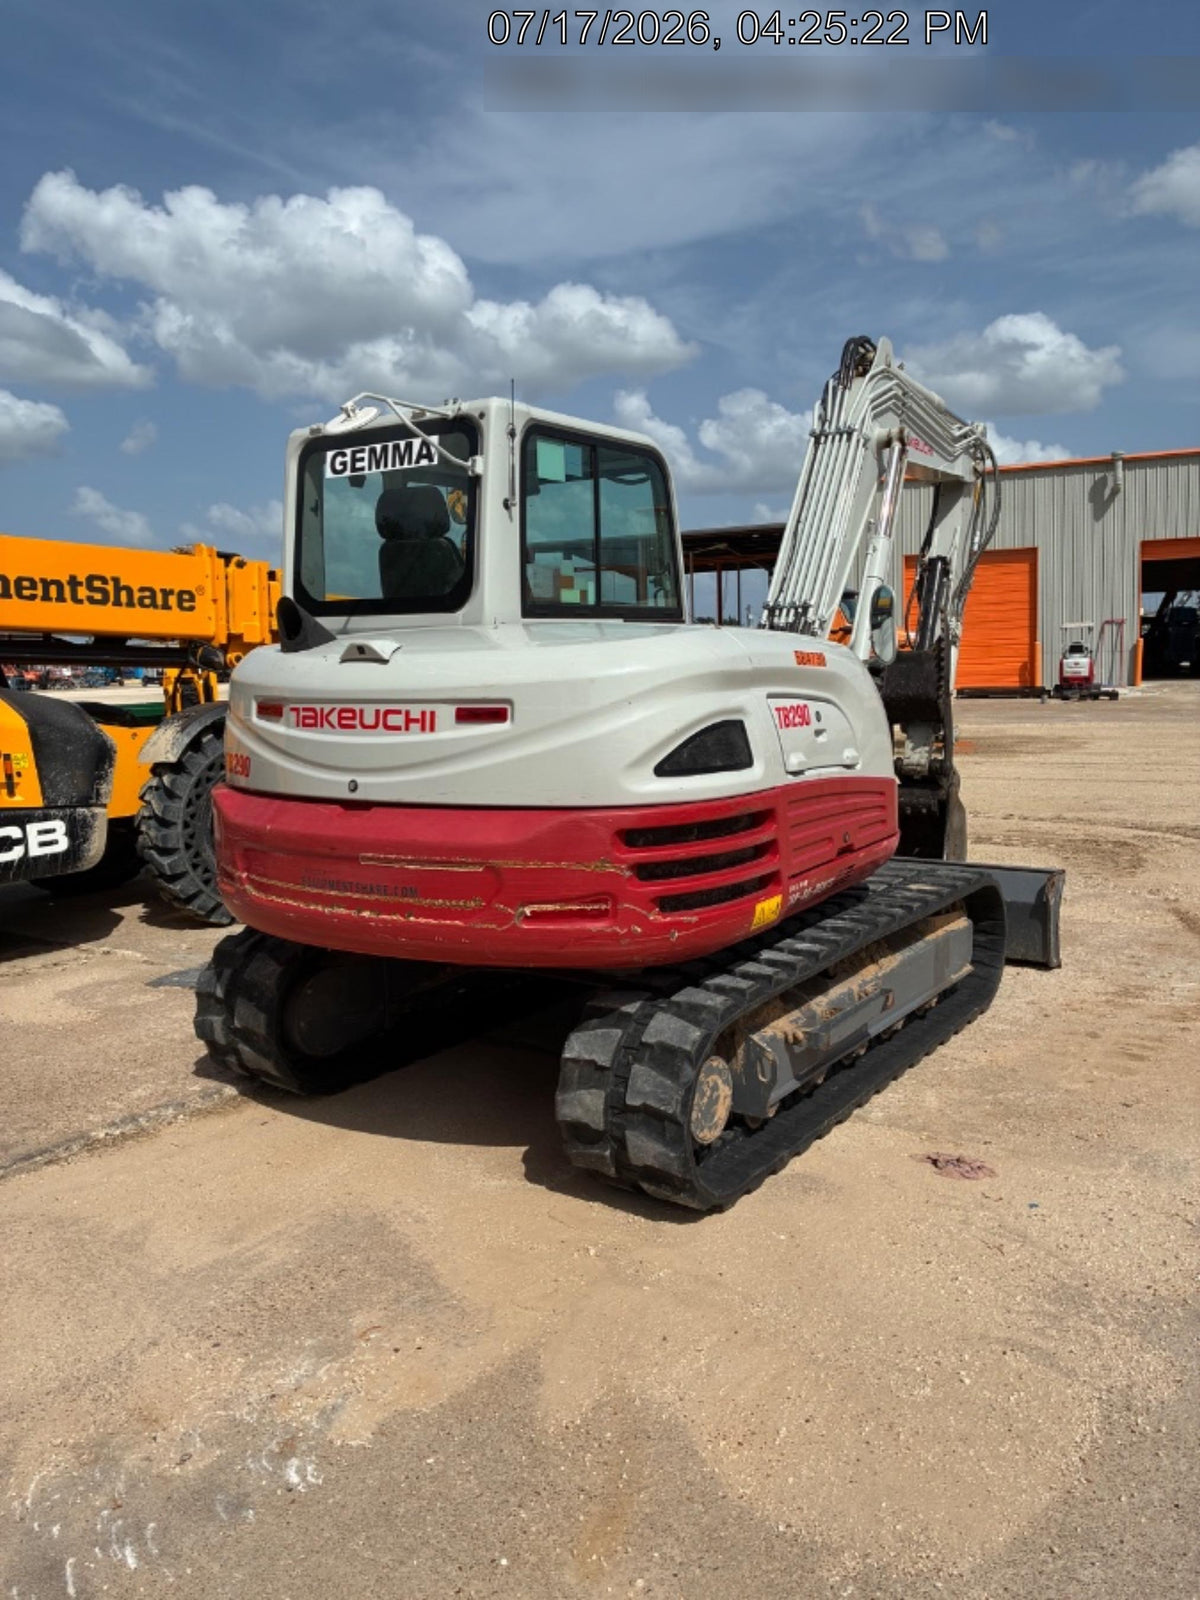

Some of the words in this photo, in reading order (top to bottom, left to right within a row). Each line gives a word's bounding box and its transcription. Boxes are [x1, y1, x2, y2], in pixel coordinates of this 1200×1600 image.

[329, 438, 436, 476] GEMMA
[289, 706, 436, 733] TAKEUCHI
[774, 703, 811, 730] TB290
